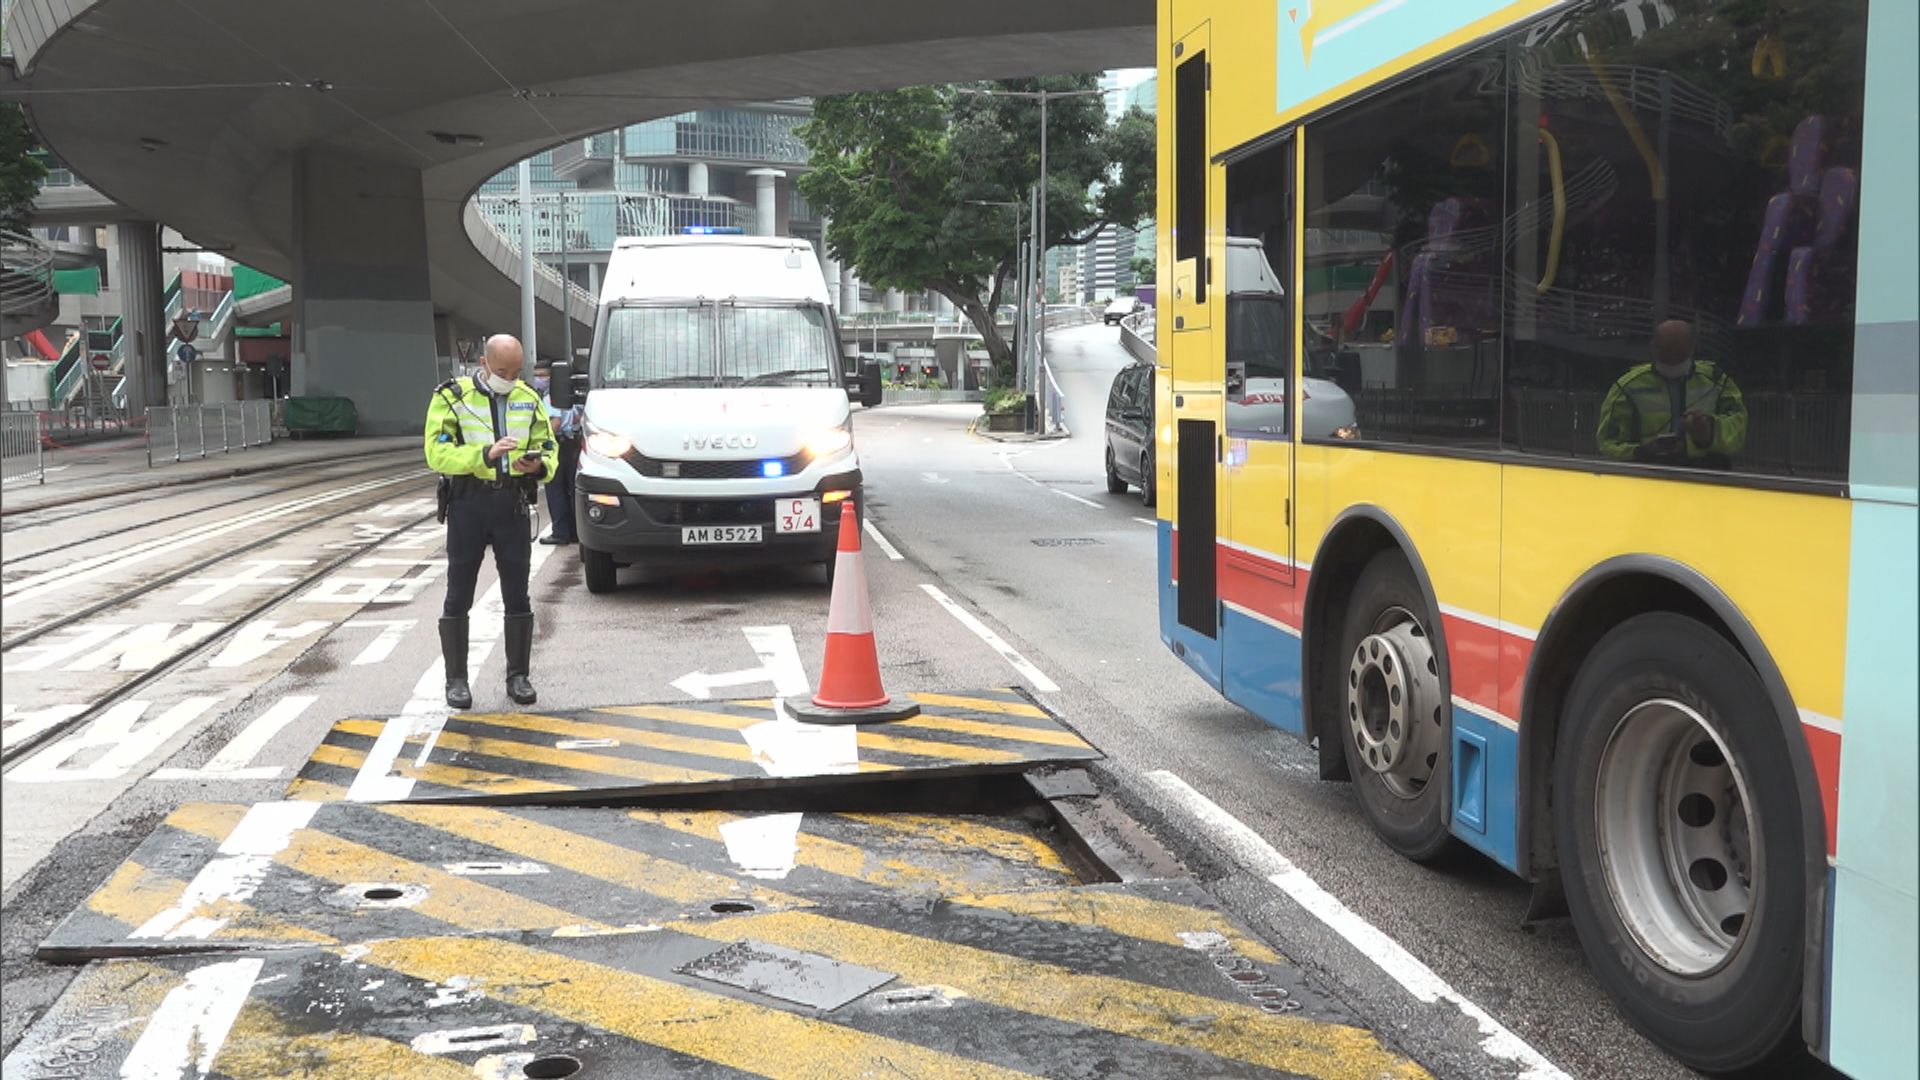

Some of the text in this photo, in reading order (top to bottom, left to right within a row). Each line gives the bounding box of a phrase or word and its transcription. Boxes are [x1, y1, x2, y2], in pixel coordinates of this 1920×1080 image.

[682, 432, 758, 450] IVECO
[792, 500, 804, 516] C
[783, 516, 814, 531] 3/4
[687, 527, 758, 542] AM 8522
